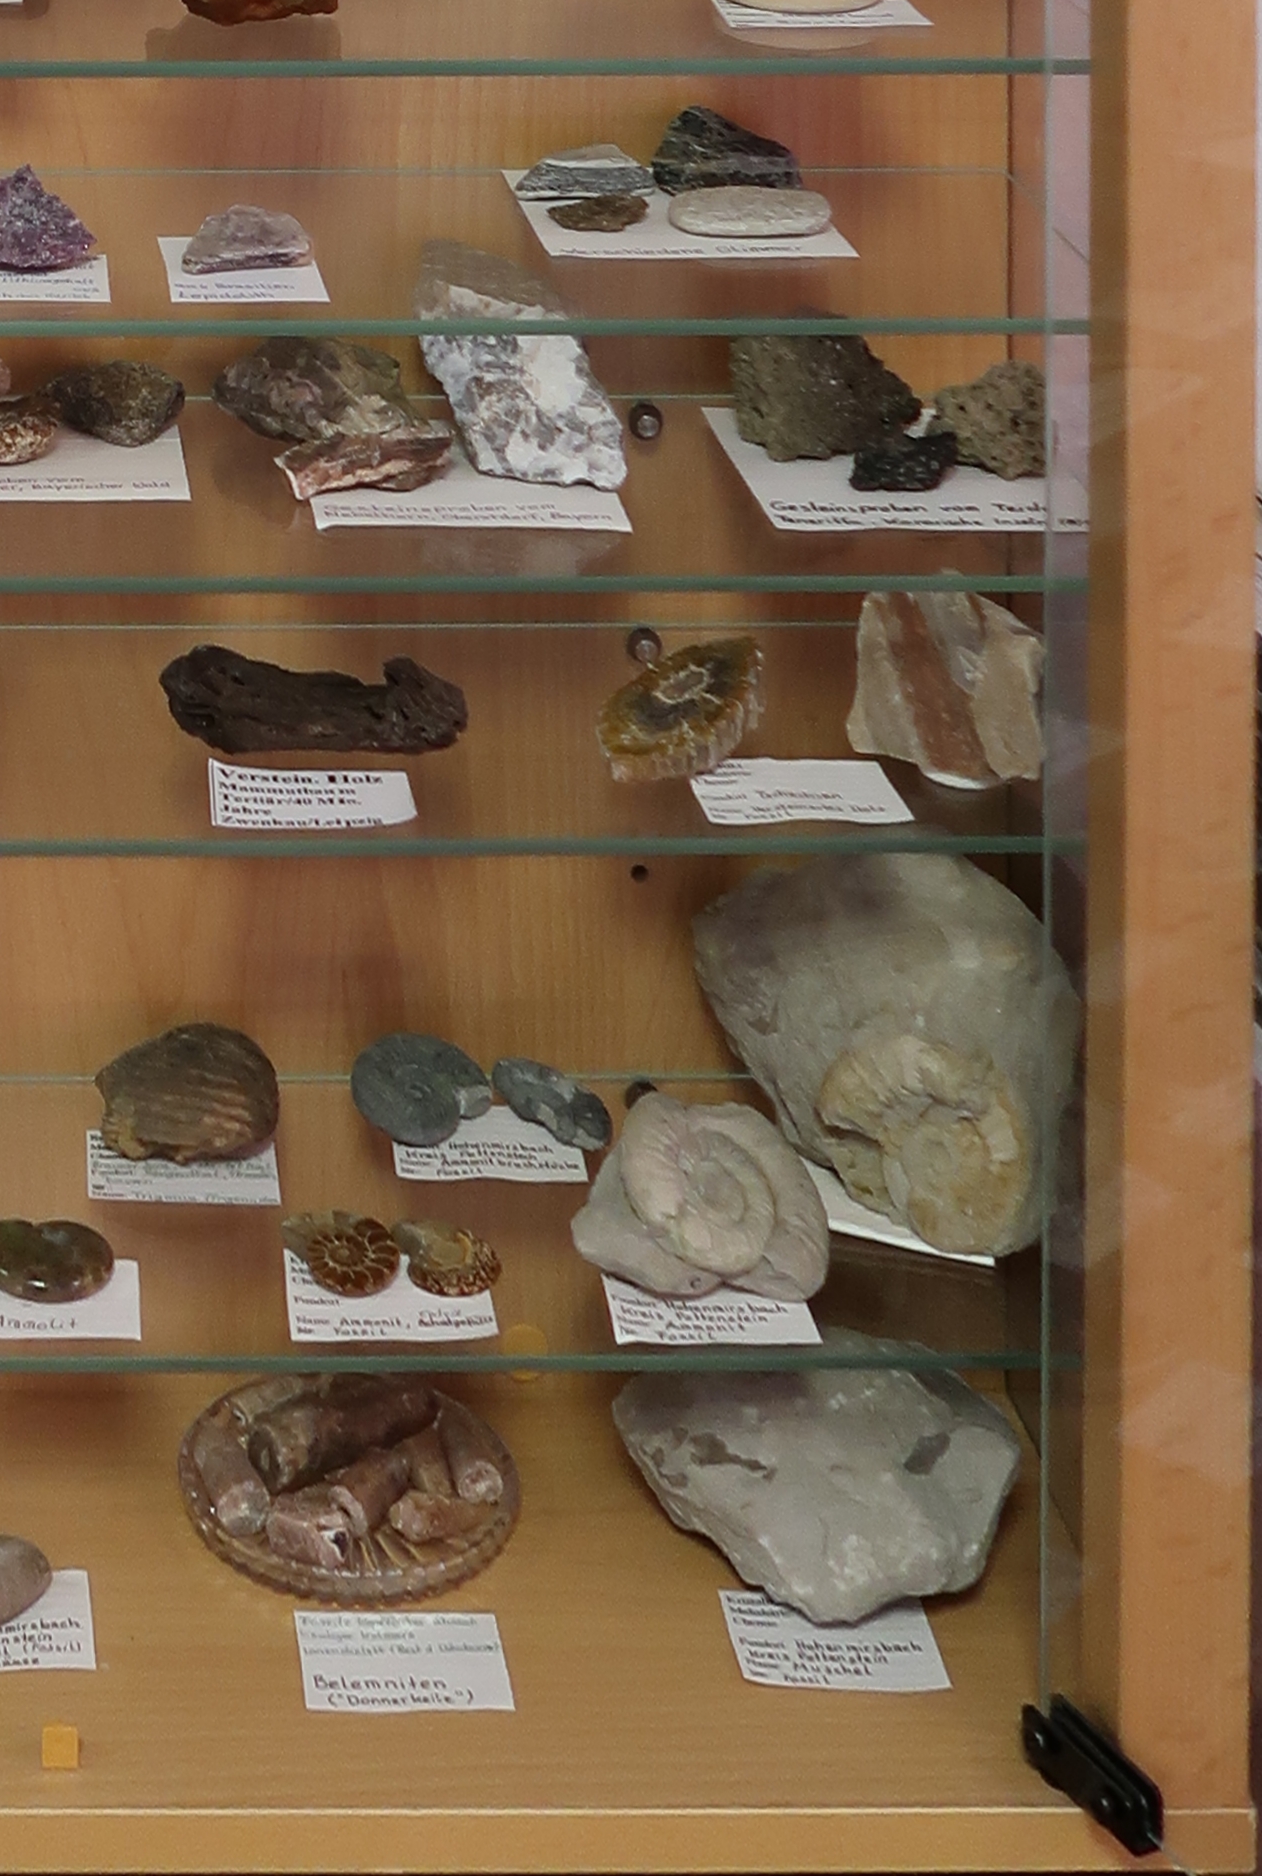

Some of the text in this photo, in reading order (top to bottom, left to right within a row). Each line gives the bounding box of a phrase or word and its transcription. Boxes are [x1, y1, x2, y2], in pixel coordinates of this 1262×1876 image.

[218, 767, 383, 785] Verstein. Holz
[220, 803, 272, 816] Jahre
[311, 1674, 448, 1692] Belemniten
